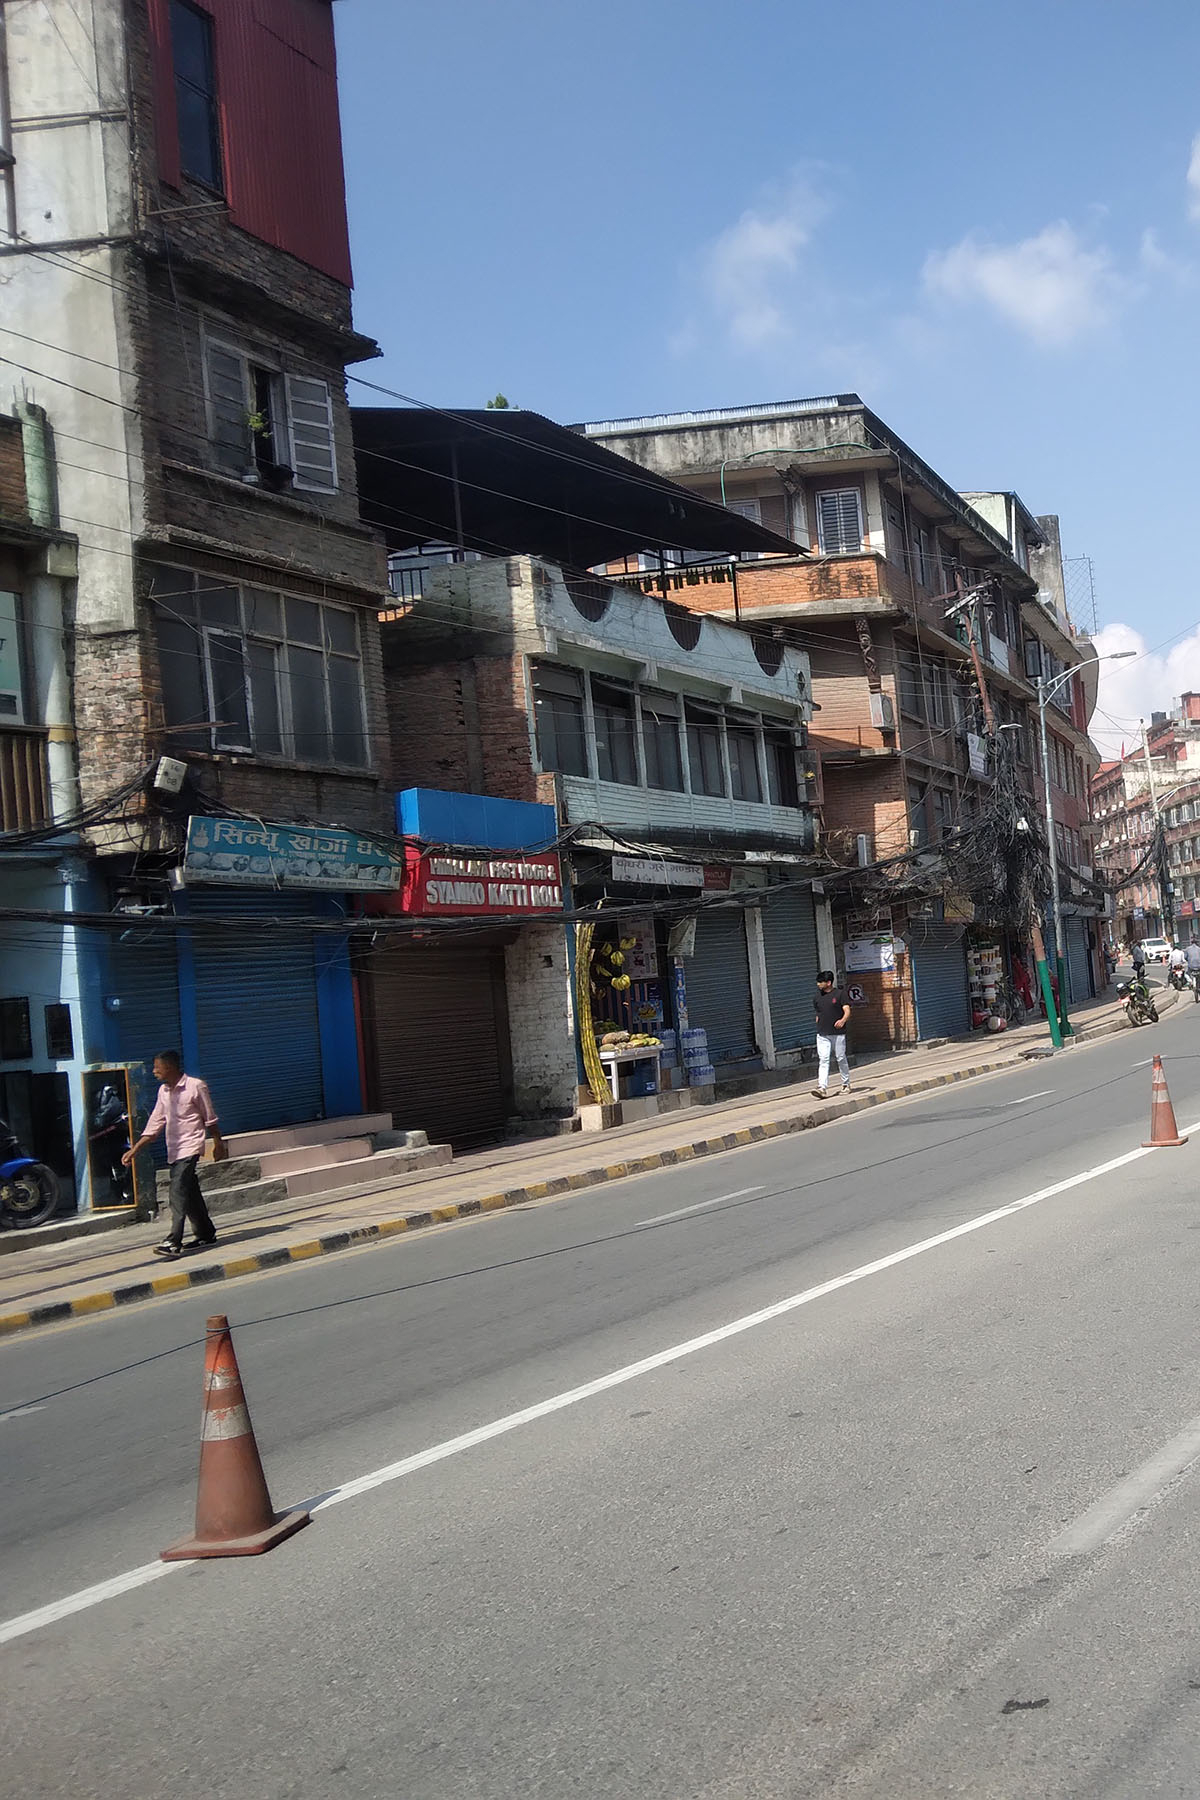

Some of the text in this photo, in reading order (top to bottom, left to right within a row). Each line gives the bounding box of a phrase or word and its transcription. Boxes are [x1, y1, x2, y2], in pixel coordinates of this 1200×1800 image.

[213, 822, 280, 854] सिन्धु
[288, 833, 349, 853] खाजा
[429, 857, 488, 877] HIMALAYA
[488, 861, 517, 879] FAST
[488, 883, 528, 906] KATTI
[531, 885, 564, 907] ROLL
